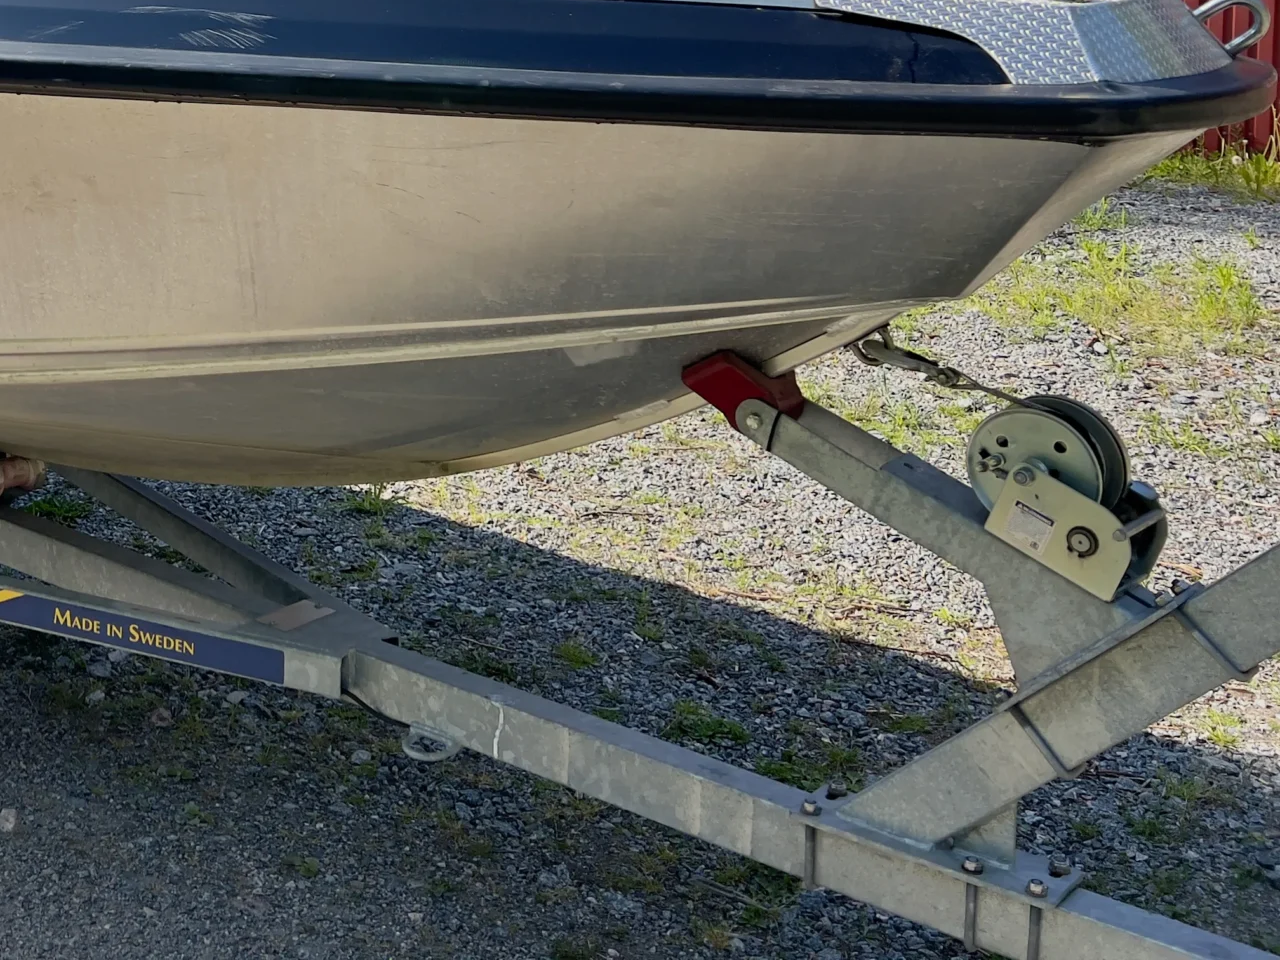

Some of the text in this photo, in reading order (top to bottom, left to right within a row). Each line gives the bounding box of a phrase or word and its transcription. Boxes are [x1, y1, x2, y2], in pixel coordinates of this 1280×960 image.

[53, 607, 195, 656] MADE IN SWEDEN
